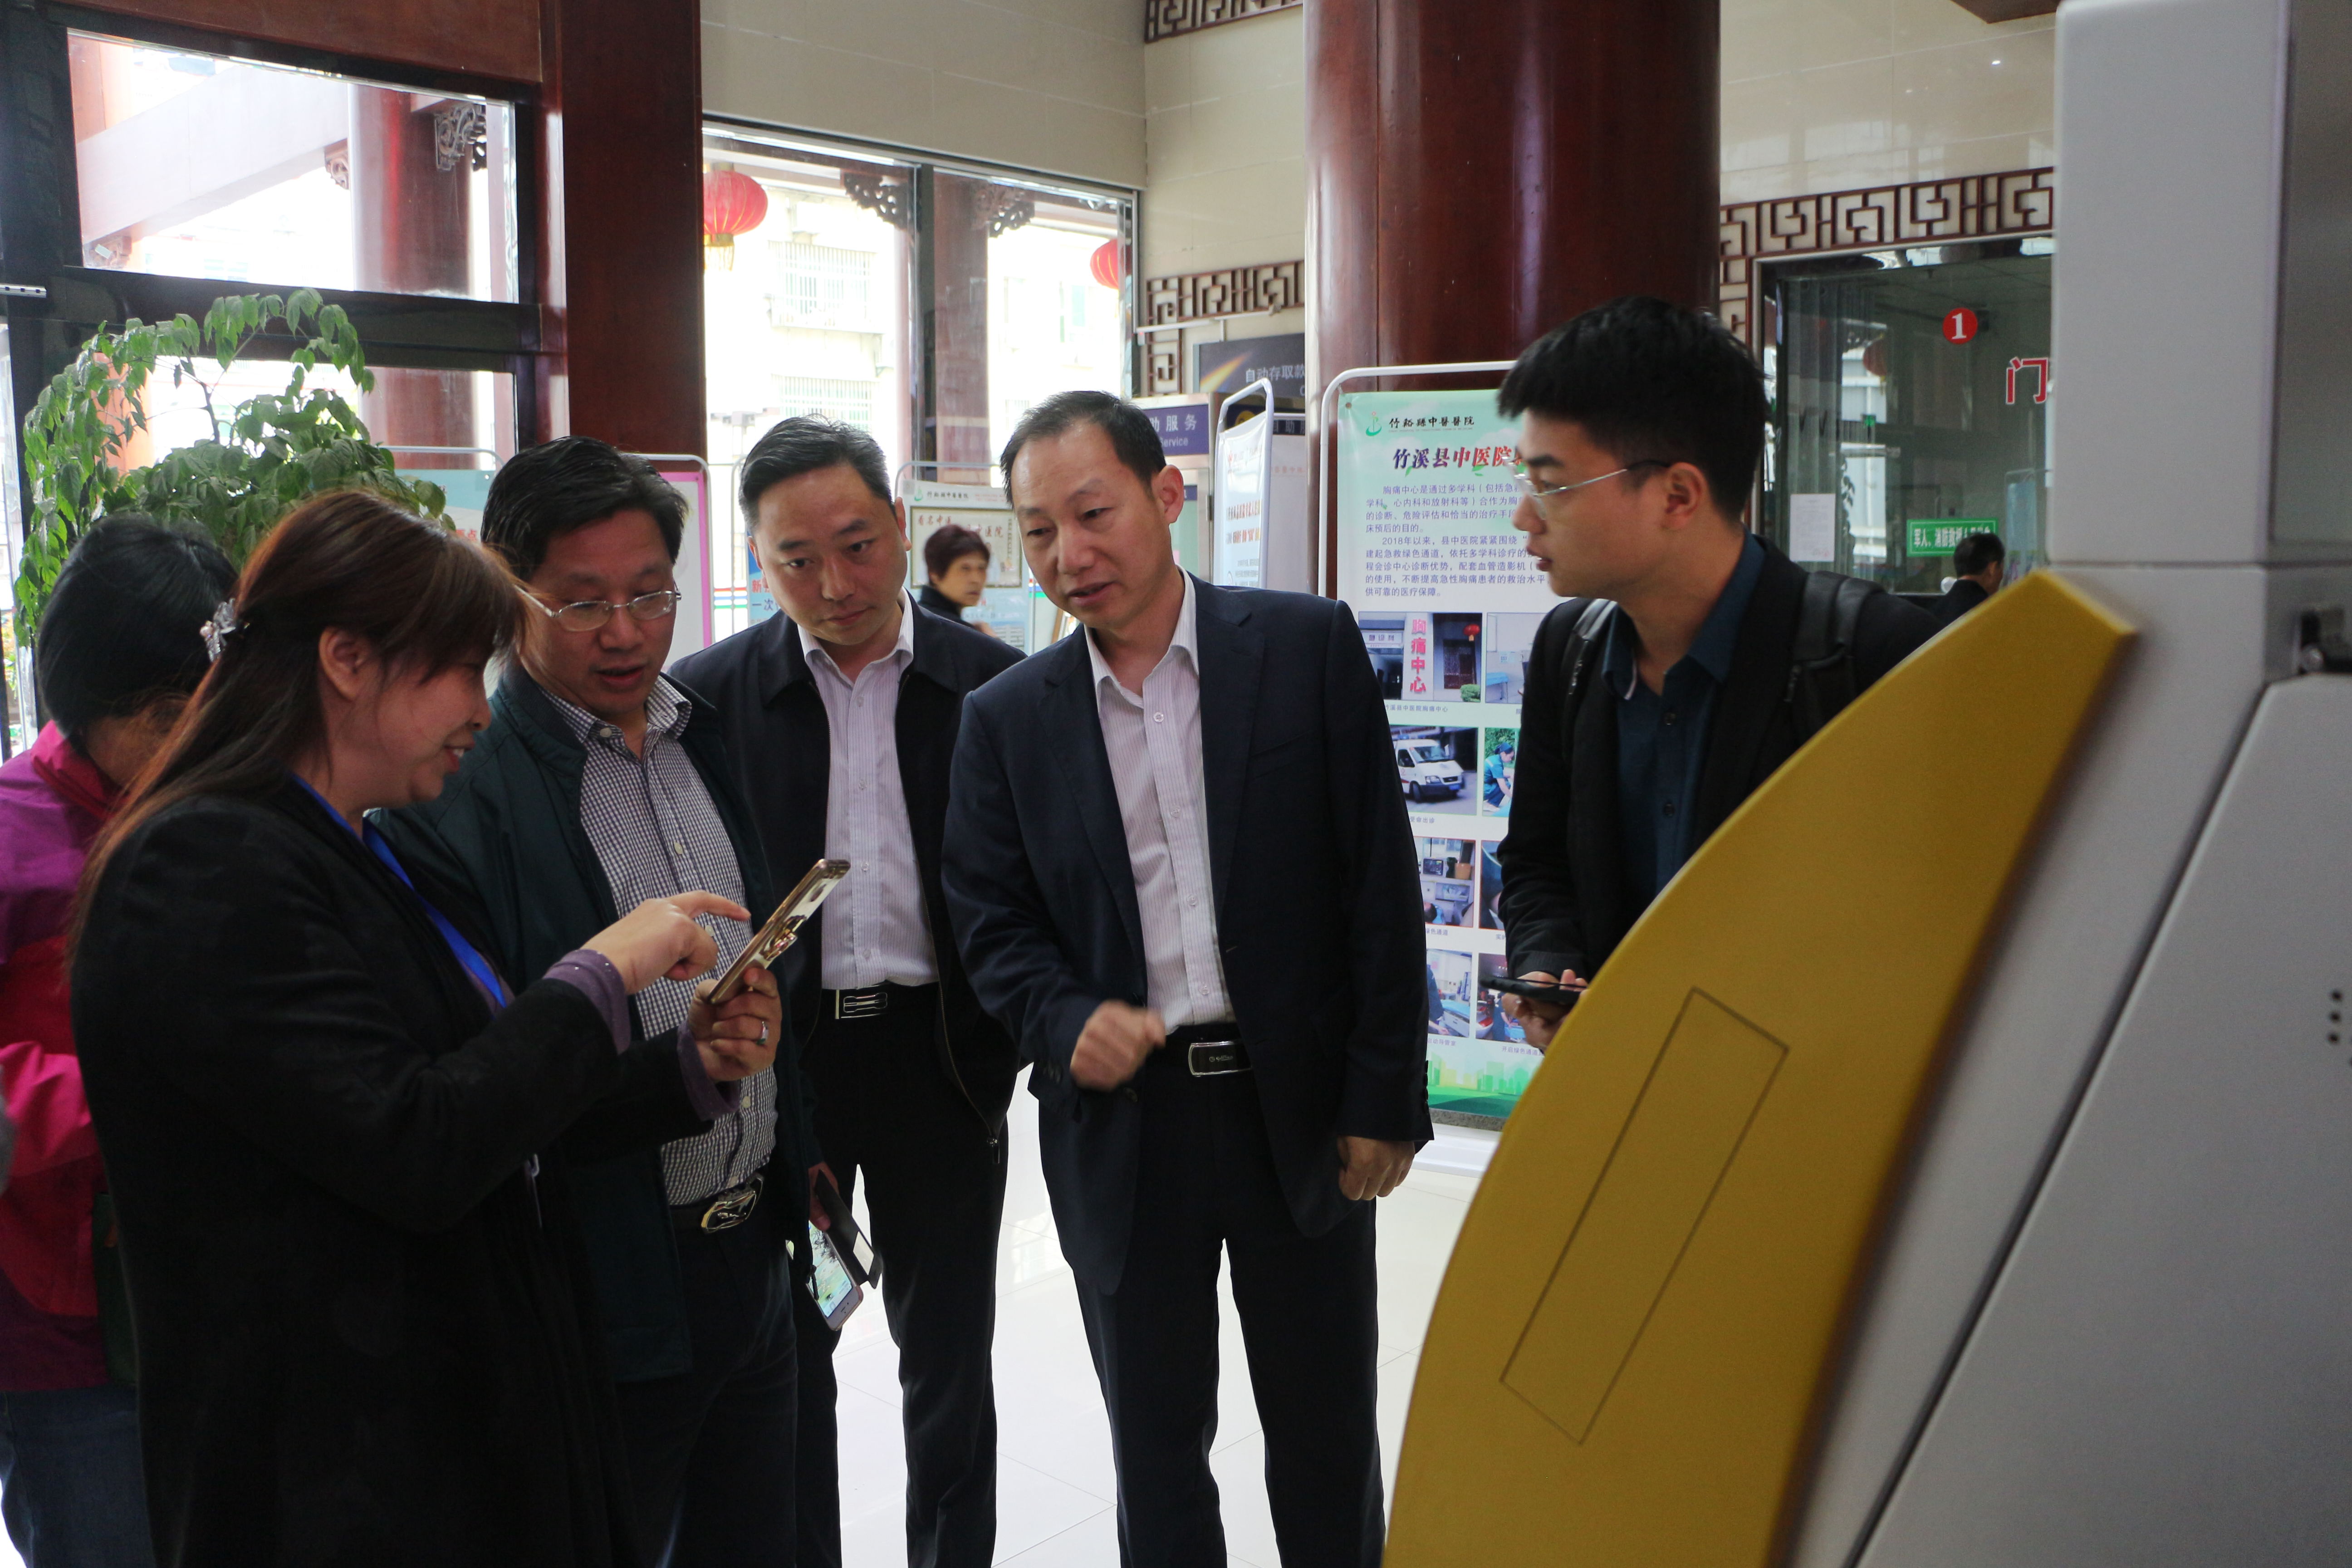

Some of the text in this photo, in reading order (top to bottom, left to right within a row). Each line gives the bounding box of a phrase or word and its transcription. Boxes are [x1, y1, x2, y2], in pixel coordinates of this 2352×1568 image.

[1952, 313, 1967, 339] 1
[1245, 363, 1305, 383] 自动存取款
[2005, 357, 2048, 405] 门
[1366, 524, 1423, 533] 床预后的目的。
[1366, 549, 1532, 559] 建起急救绿色通道，依托多学科诊疗的
[1366, 561, 1539, 571] 程会诊中心诊断优势，配套血管造影机（
[1366, 587, 1441, 597] 供可靠的医疗保障。
[1410, 619, 1426, 693] 胸痛中心
